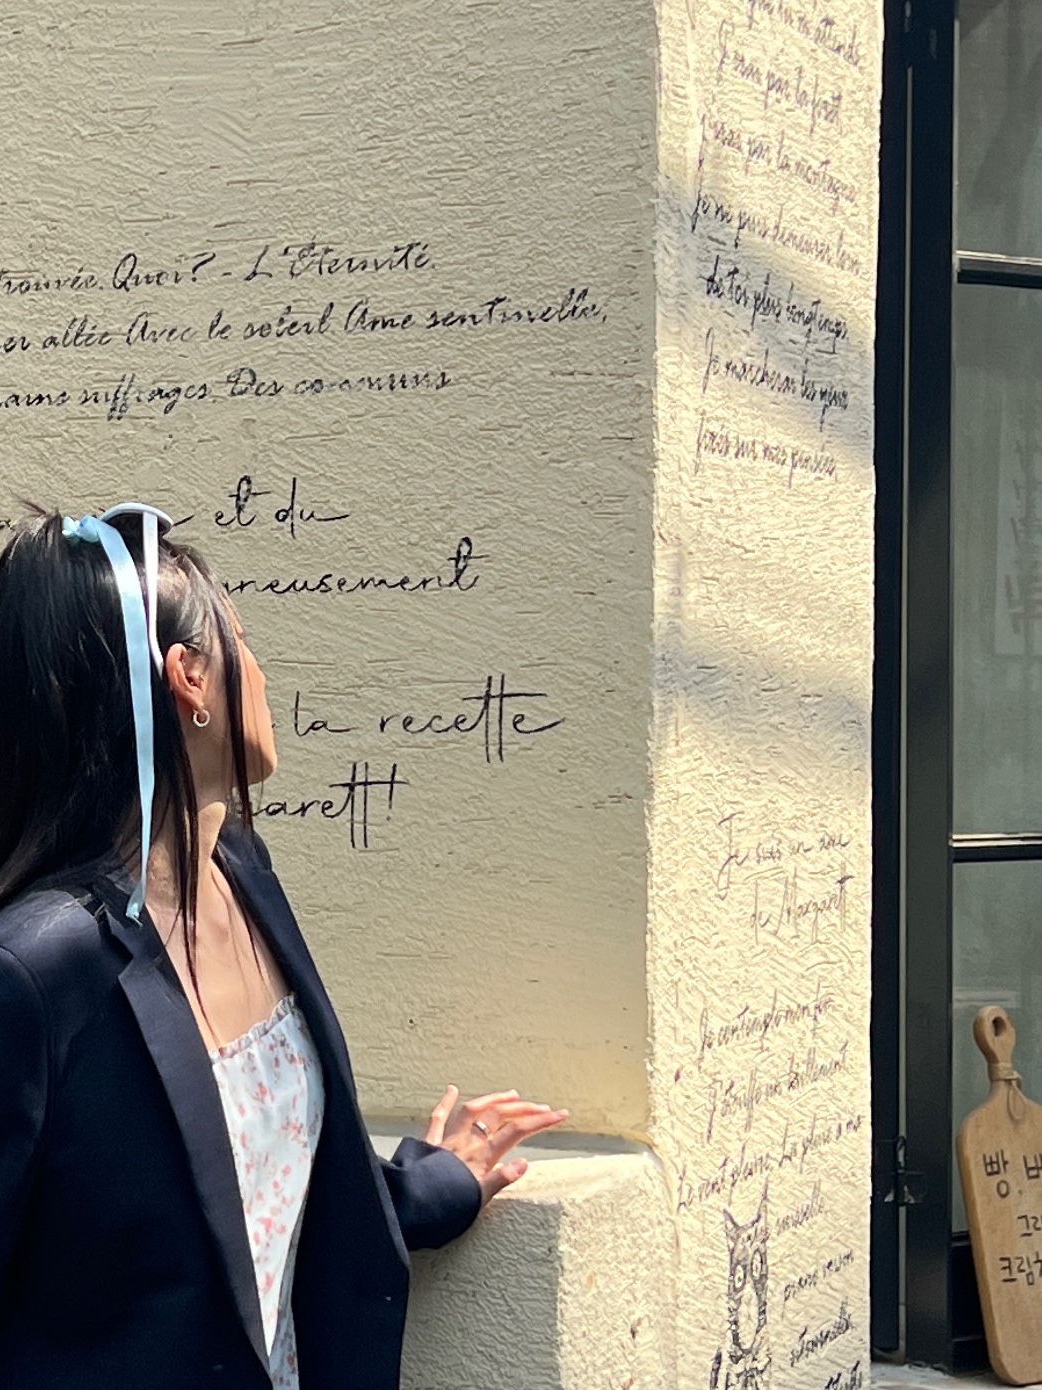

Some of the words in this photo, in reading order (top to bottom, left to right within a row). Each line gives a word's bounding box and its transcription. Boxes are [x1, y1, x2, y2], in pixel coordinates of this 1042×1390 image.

[208, 308, 231, 340] le
[243, 301, 335, 340] soleil
[226, 366, 285, 397] Des
[214, 475, 271, 528] et
[275, 477, 351, 539] du
[294, 690, 358, 737] la
[379, 673, 566, 764] recette
